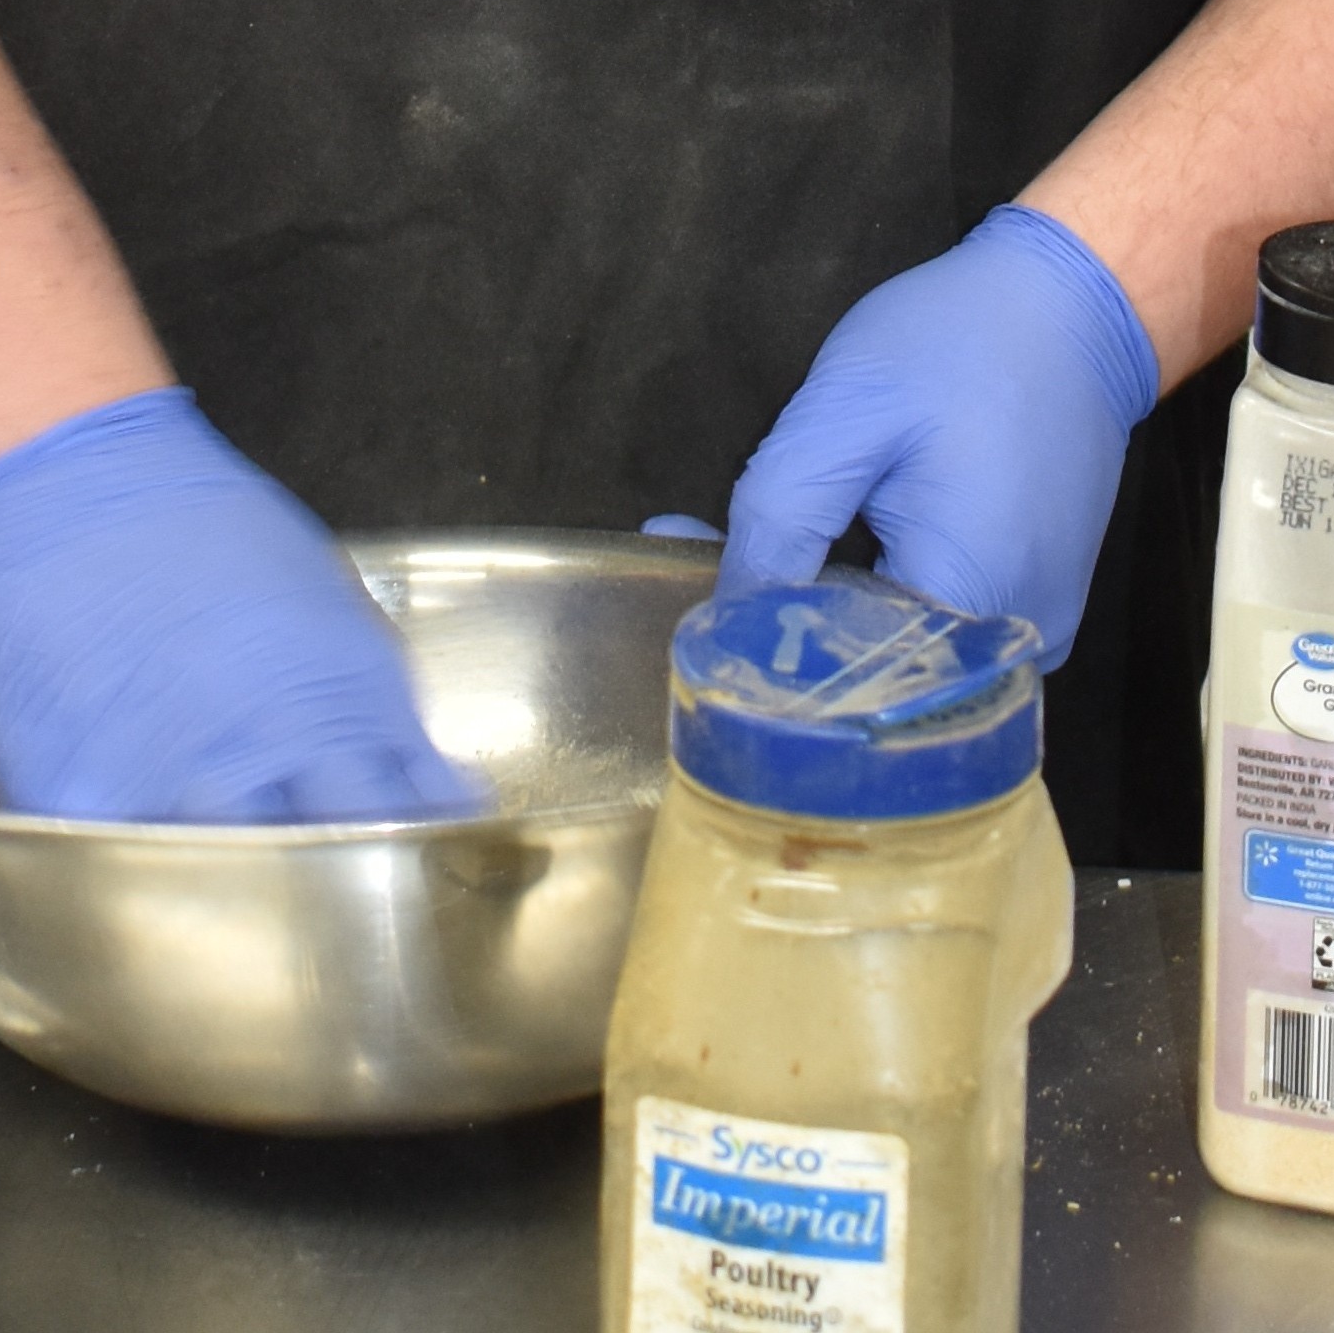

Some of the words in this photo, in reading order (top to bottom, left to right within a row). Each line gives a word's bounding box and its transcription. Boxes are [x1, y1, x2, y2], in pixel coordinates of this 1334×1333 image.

[1282, 474, 1318, 496] DEC
[1280, 492, 1328, 514] BEST
[1279, 510, 1312, 531] JUN
[1237, 762, 1306, 783] DISTRIBUTED
[1279, 1093, 1329, 1116] 78742
[710, 1123, 823, 1174] Sysco
[660, 1162, 883, 1247] Imperial
[709, 1249, 822, 1304] Poultry
[705, 1285, 824, 1332] Seasoning
